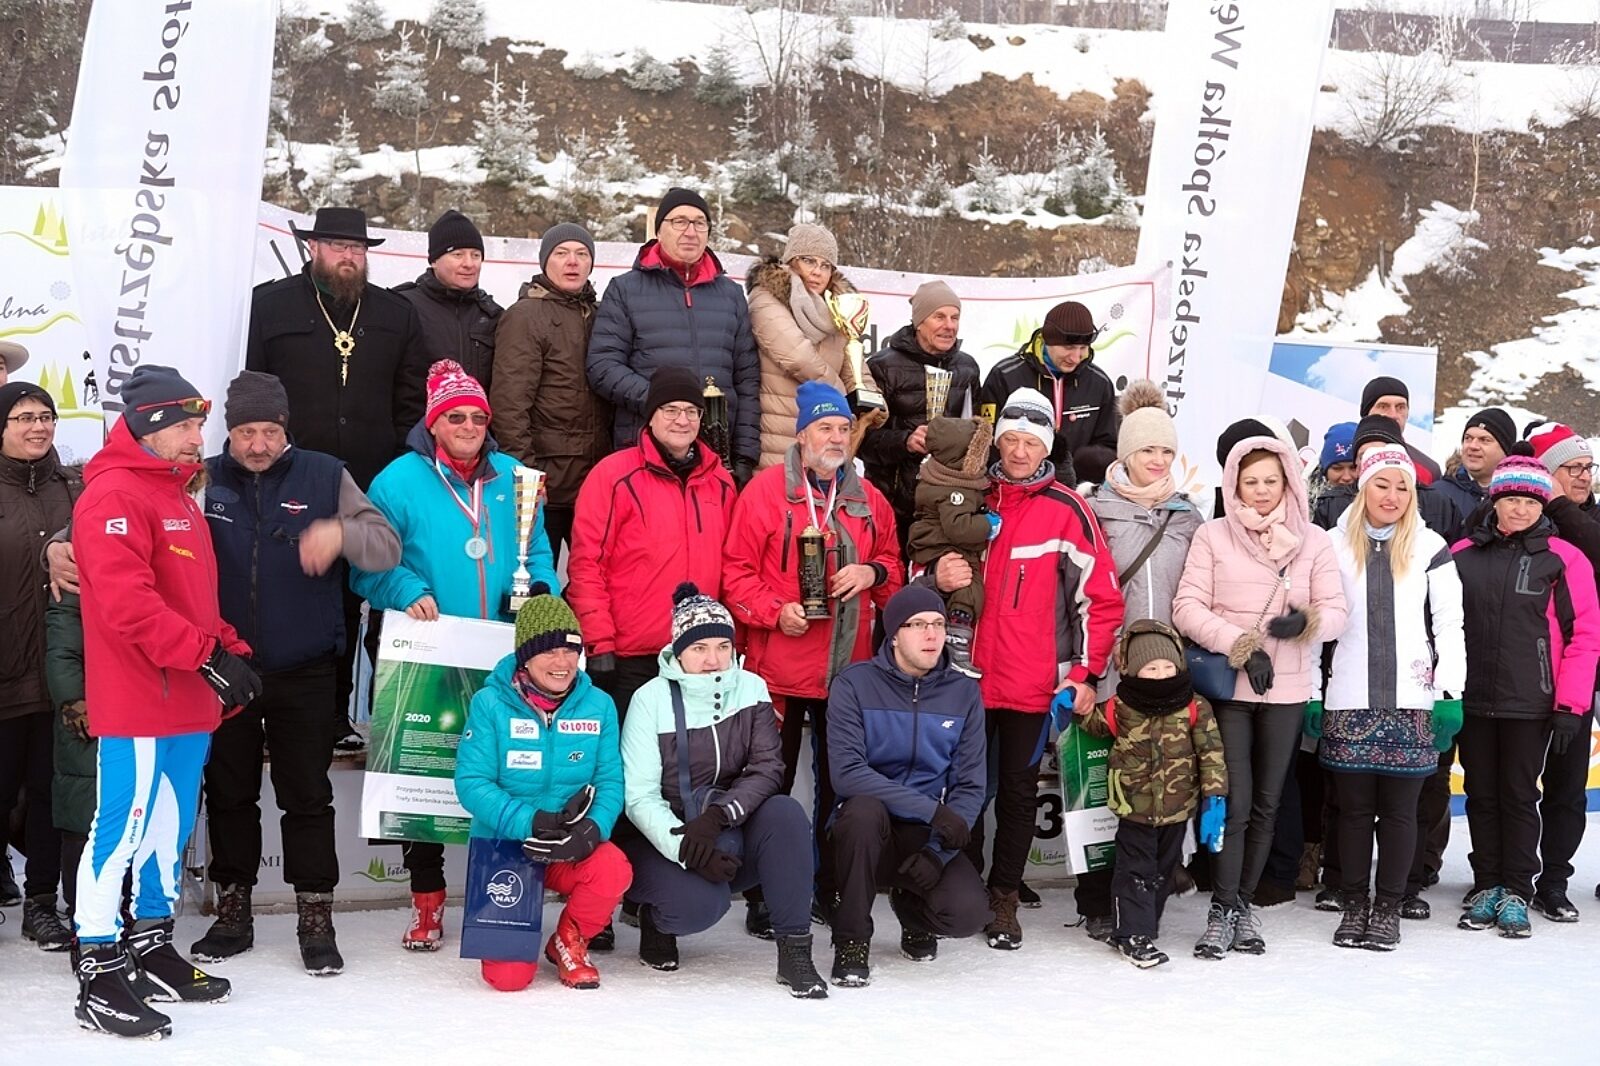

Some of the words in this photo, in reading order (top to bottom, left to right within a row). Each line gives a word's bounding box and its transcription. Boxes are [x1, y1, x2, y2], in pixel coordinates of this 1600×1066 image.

[392, 638, 413, 650] GPI
[405, 712, 432, 723] 2020
[571, 722, 598, 732] LOTOS
[1086, 749, 1109, 760] 2020
[1033, 793, 1064, 839] 3
[495, 895, 518, 903] NAT
